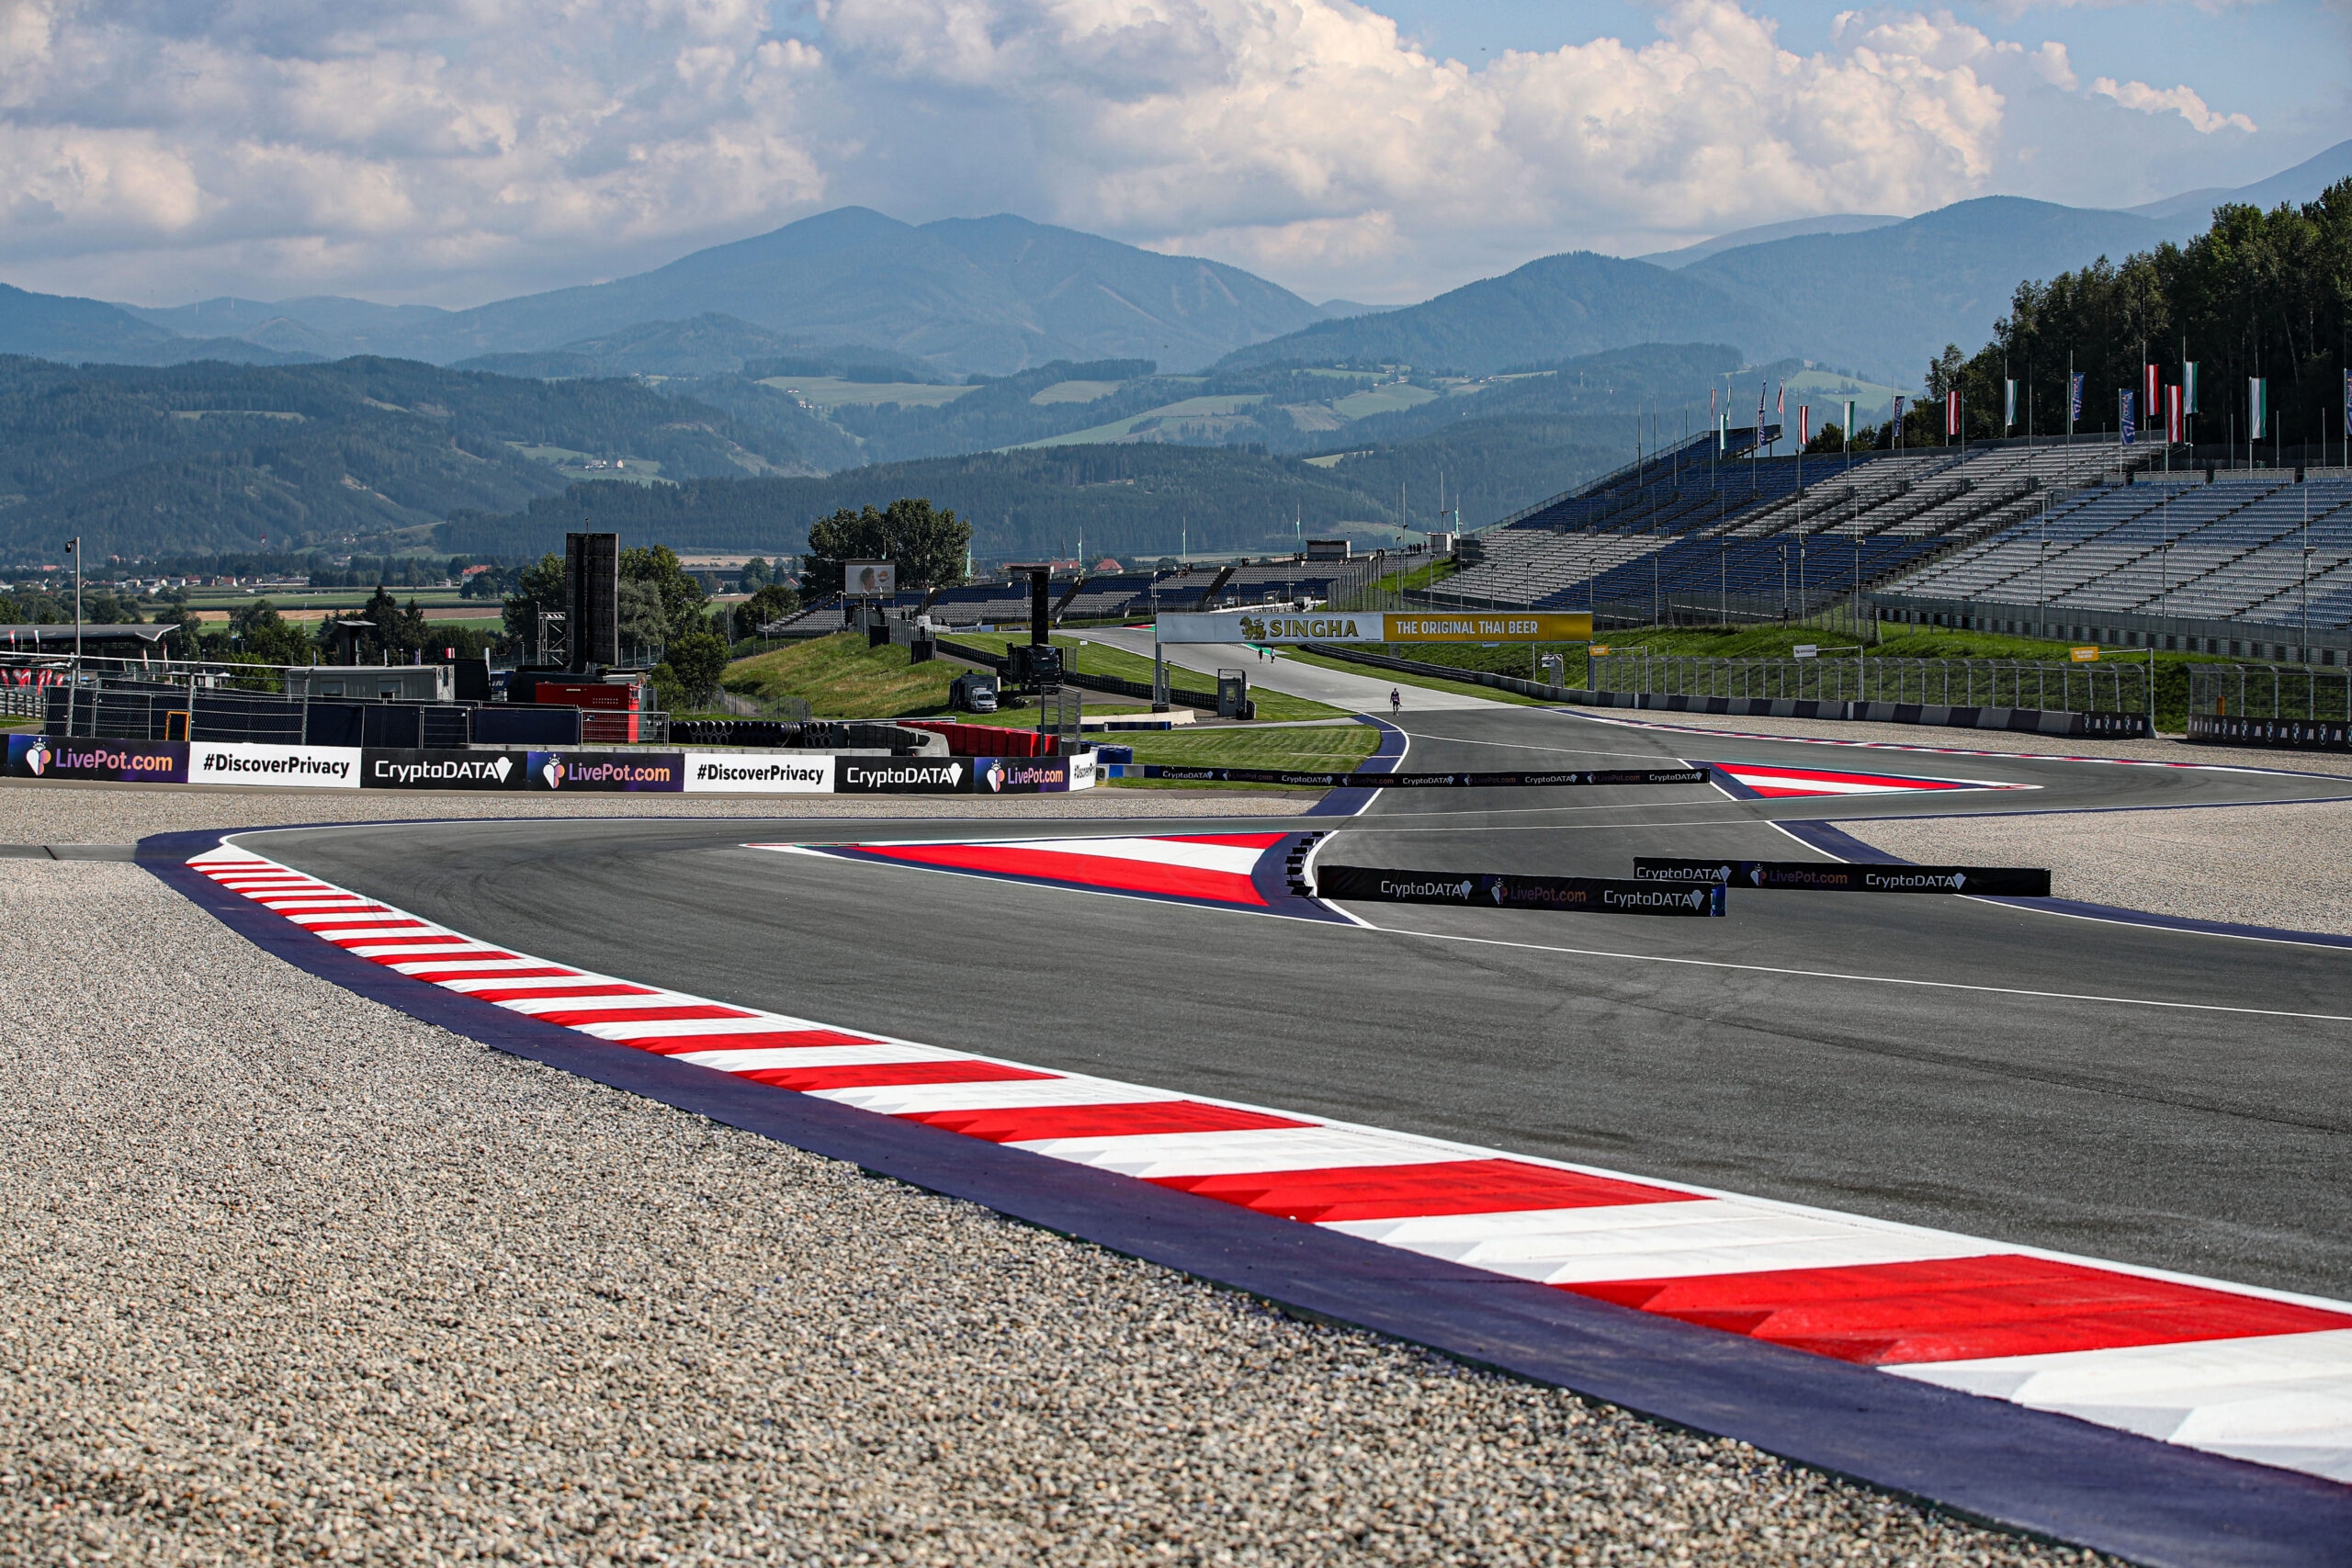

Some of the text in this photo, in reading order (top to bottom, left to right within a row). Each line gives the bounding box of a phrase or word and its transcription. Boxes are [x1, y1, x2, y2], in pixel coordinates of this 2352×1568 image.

[1270, 619, 1359, 637] SINGHA
[1396, 621, 1539, 635] THE ORIGINAL THAI BEER
[56, 748, 173, 772] LivePot.com
[203, 753, 350, 778] #DiscoverPrivacy
[374, 760, 498, 783] CryptoDATA
[569, 762, 670, 782] LivePot.com
[696, 763, 825, 785] #DiscoverPrivacy
[847, 766, 952, 787] CryptoDATA
[1007, 767, 1064, 784] LivePot.com
[1162, 770, 1209, 780] CryptoDATA
[1282, 774, 1328, 784] CryptoDATA
[1524, 774, 1572, 784] CryptoDATA
[1649, 773, 1696, 783] CryptoDATA
[1402, 776, 1449, 786] CryptoDATA
[1635, 866, 1721, 880] CryptoDATA
[1769, 869, 1848, 884] LivePot.com
[1866, 874, 1952, 889] CryptoDATA
[1380, 880, 1462, 898] CryptoDATA
[1510, 885, 1587, 903] LivePot.com
[1603, 890, 1692, 908] CryptoDATA
